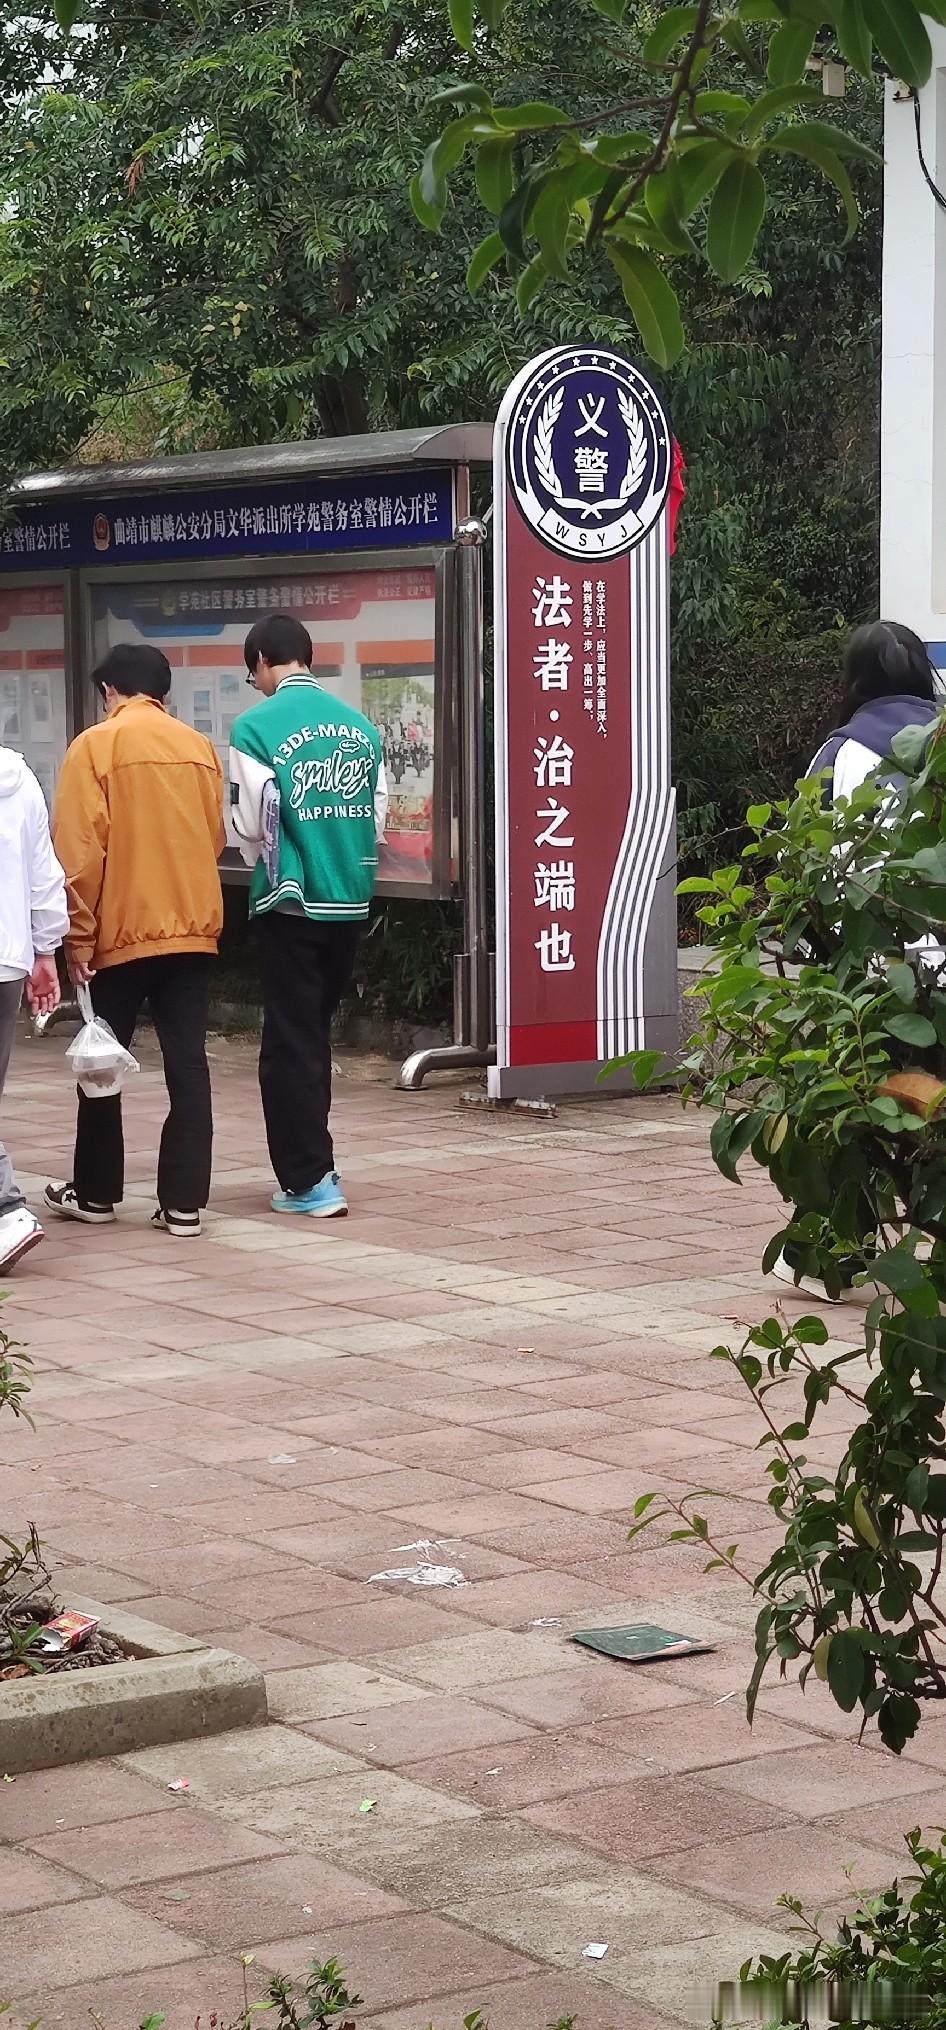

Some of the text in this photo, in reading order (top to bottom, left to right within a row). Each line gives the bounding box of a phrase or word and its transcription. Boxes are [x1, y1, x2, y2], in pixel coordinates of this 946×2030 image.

[574, 392, 609, 493] 义警
[0, 521, 71, 553] 室警情公开栏
[114, 491, 438, 546] 曲靖市麒麟公安分局文华派出所学苑警务室警情公开栏
[298, 804, 372, 822] HAPPINESS
